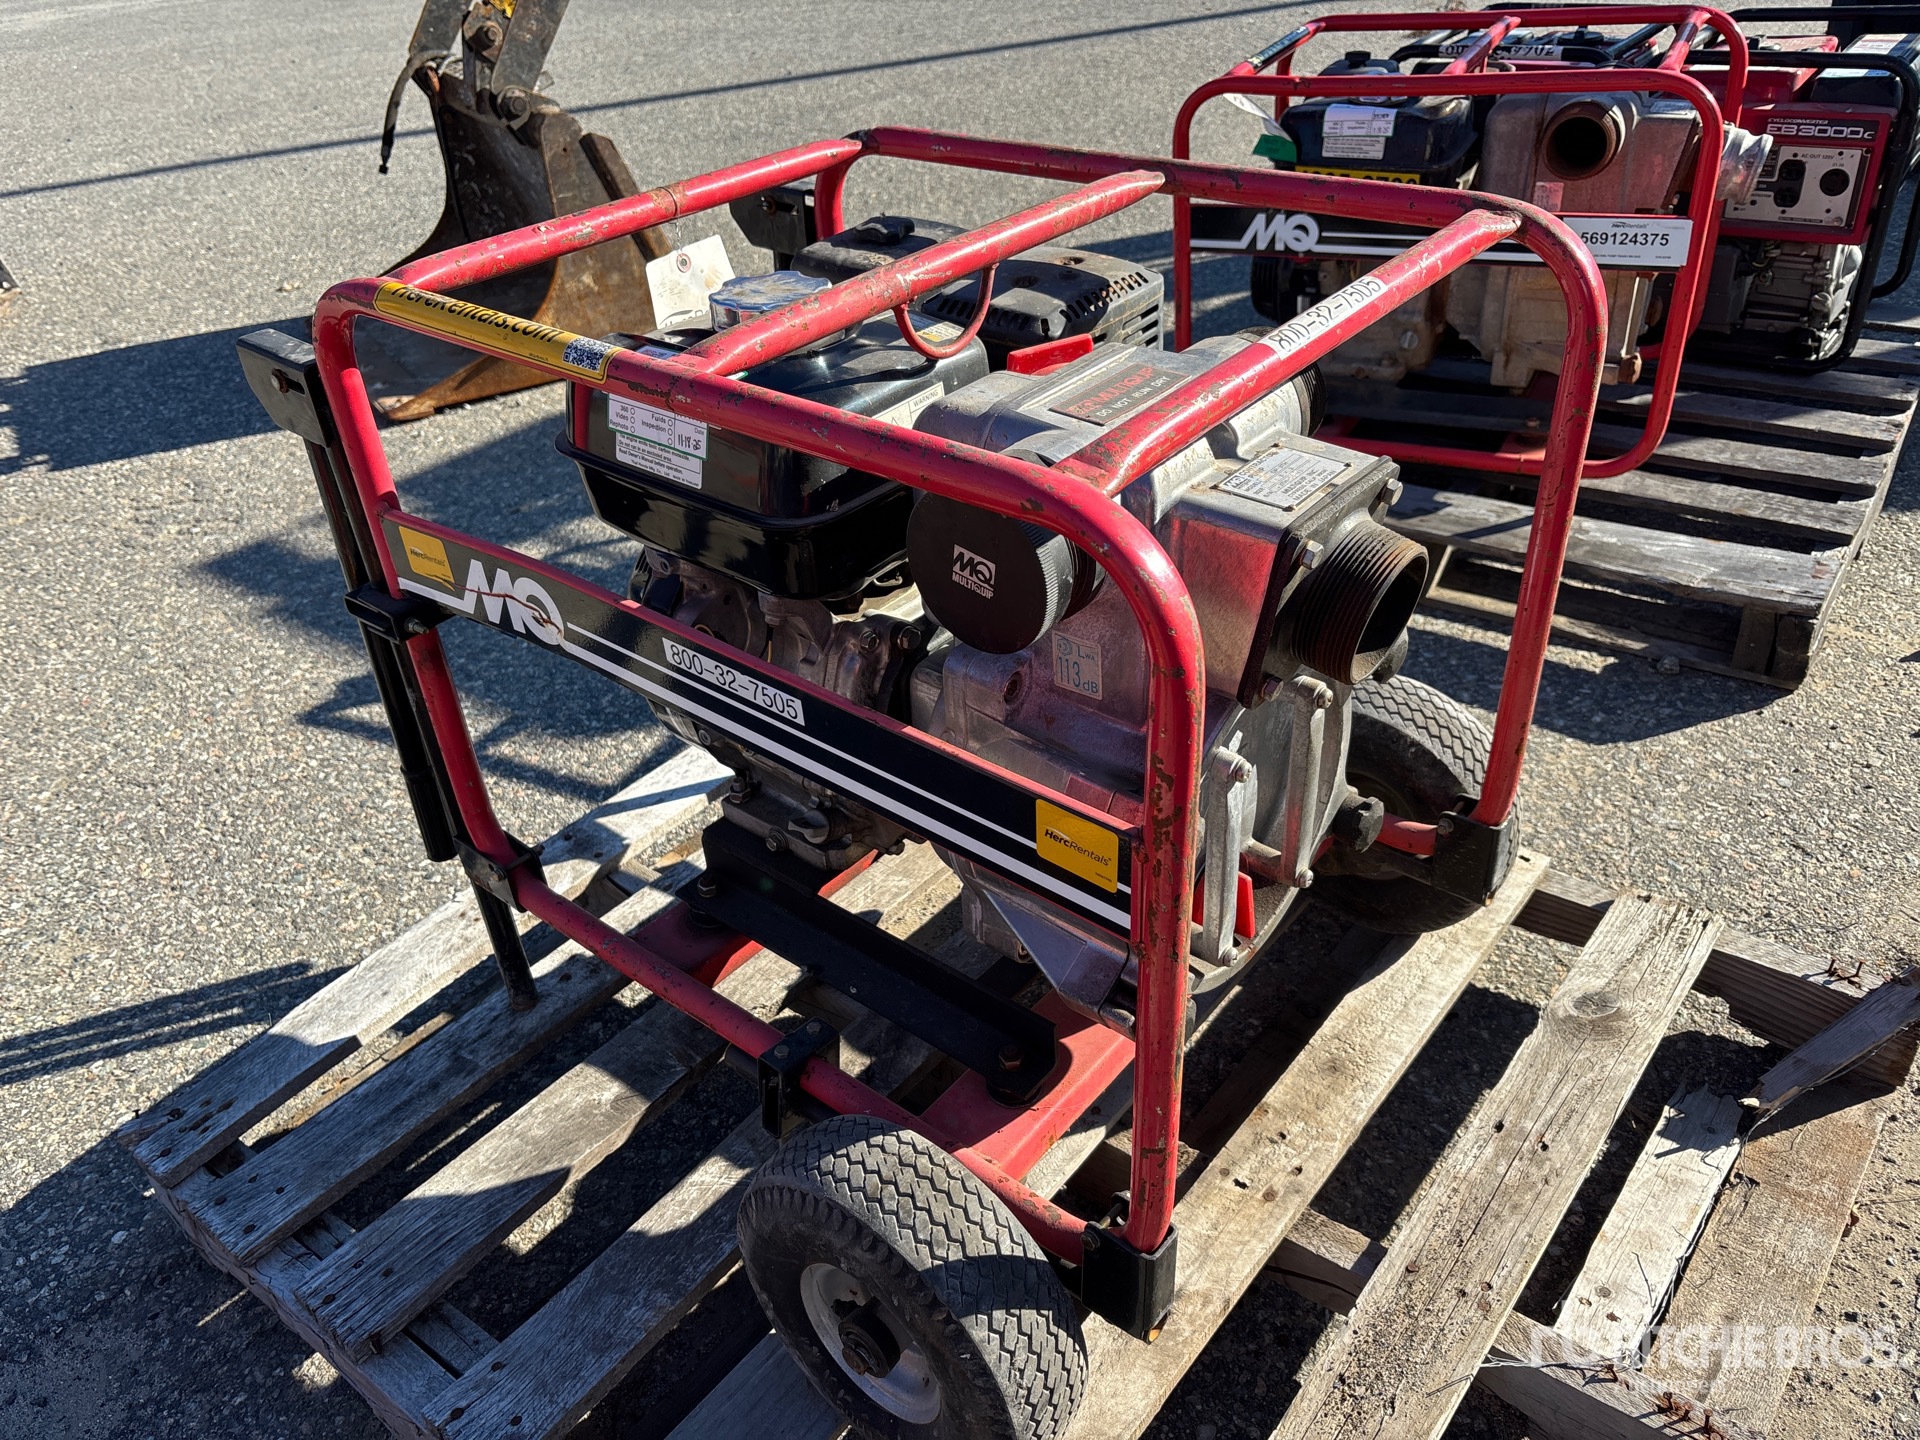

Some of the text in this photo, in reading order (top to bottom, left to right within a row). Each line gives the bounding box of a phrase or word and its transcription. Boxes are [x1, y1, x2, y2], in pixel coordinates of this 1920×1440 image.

[1241, 213, 1320, 252] MQ
[1581, 231, 1670, 247] 569124375
[1268, 279, 1382, 353] 800-32-7505
[913, 389, 939, 407] WARNING
[1096, 375, 1171, 417] DO NOT RUN DRY
[615, 411, 629, 422] Video
[952, 571, 994, 599] MULTIQUIP
[953, 551, 994, 586] MQ
[463, 558, 565, 646] MQ
[670, 643, 798, 720] 800-32-7505
[1058, 656, 1099, 694] 113 dB
[1044, 828, 1109, 867] HercRentals
